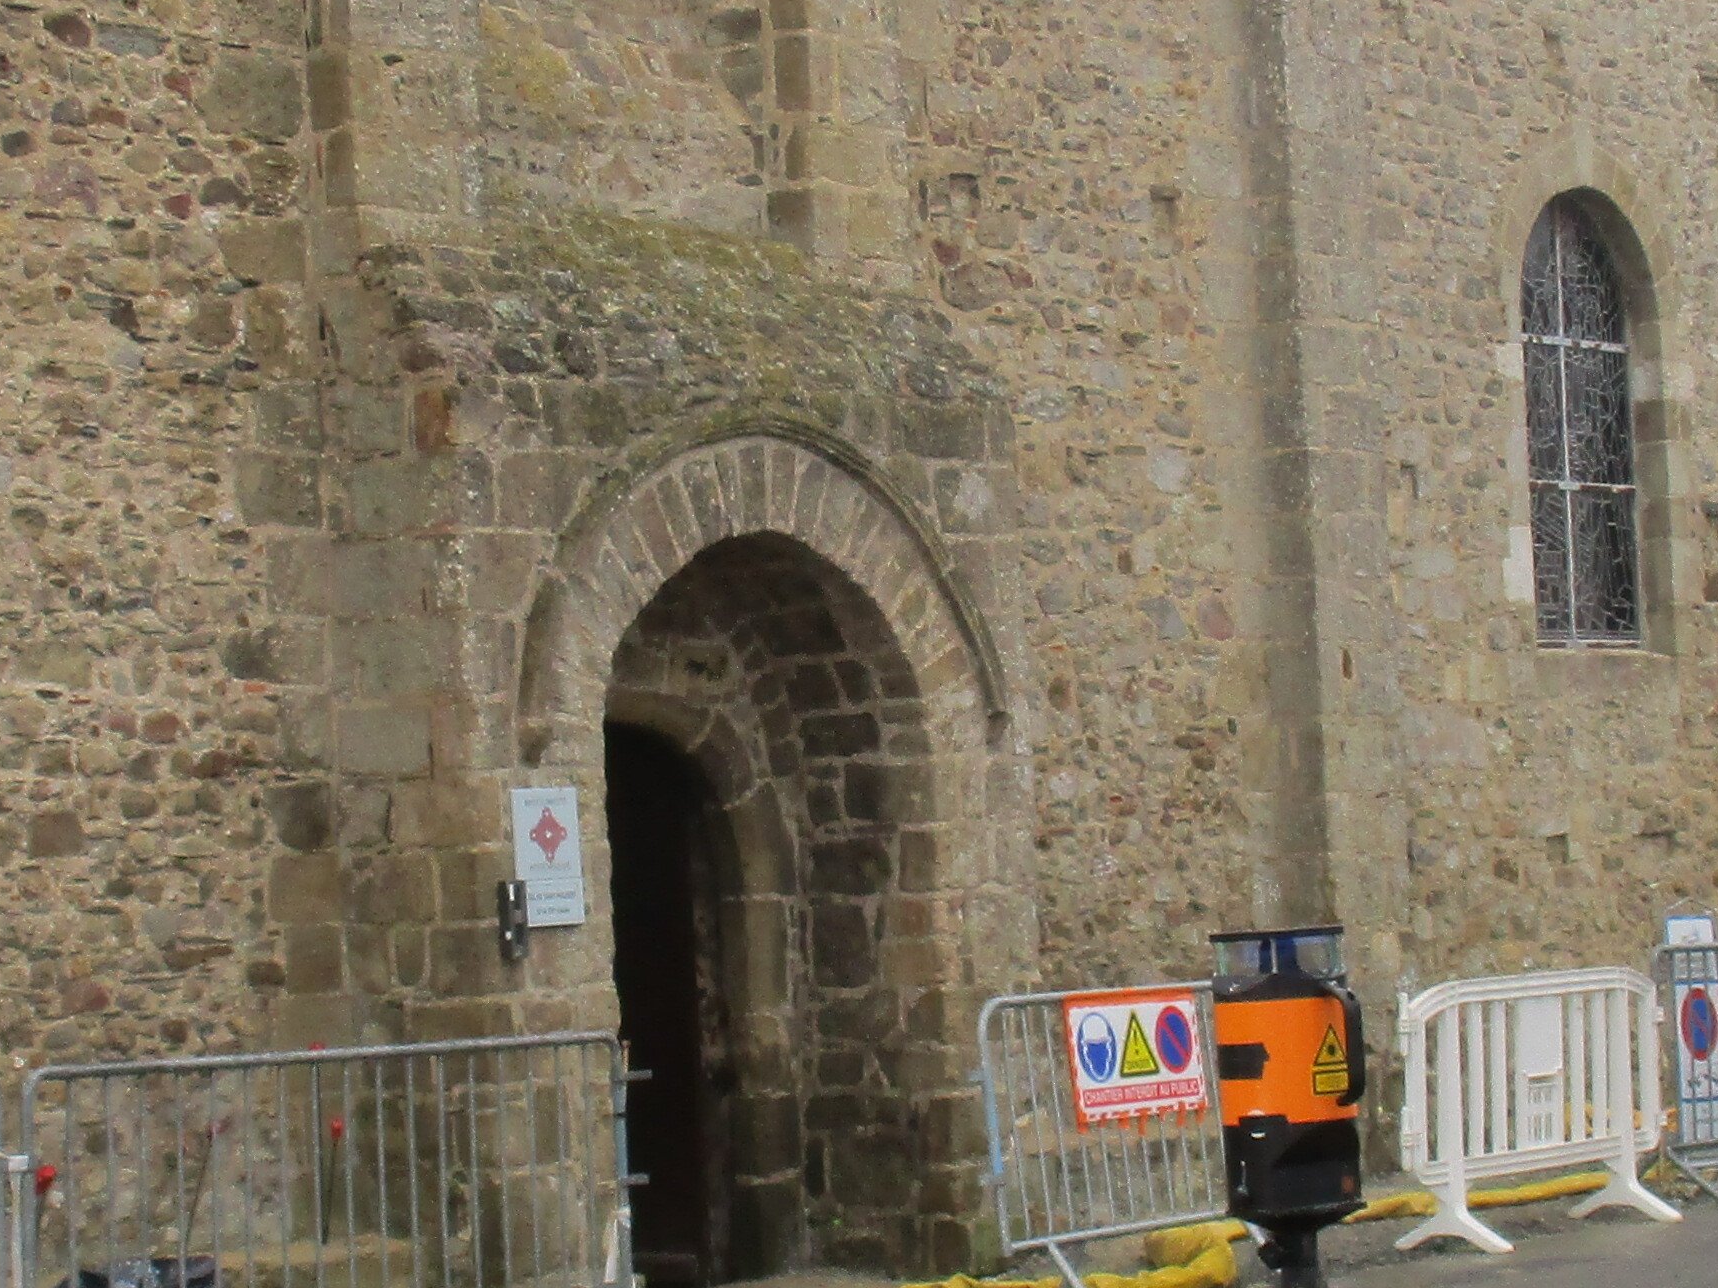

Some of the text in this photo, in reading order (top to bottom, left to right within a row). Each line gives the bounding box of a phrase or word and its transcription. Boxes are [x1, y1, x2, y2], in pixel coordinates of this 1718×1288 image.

[1084, 1079, 1198, 1105] CHANTIER INTERDIT AU PUBLIC
